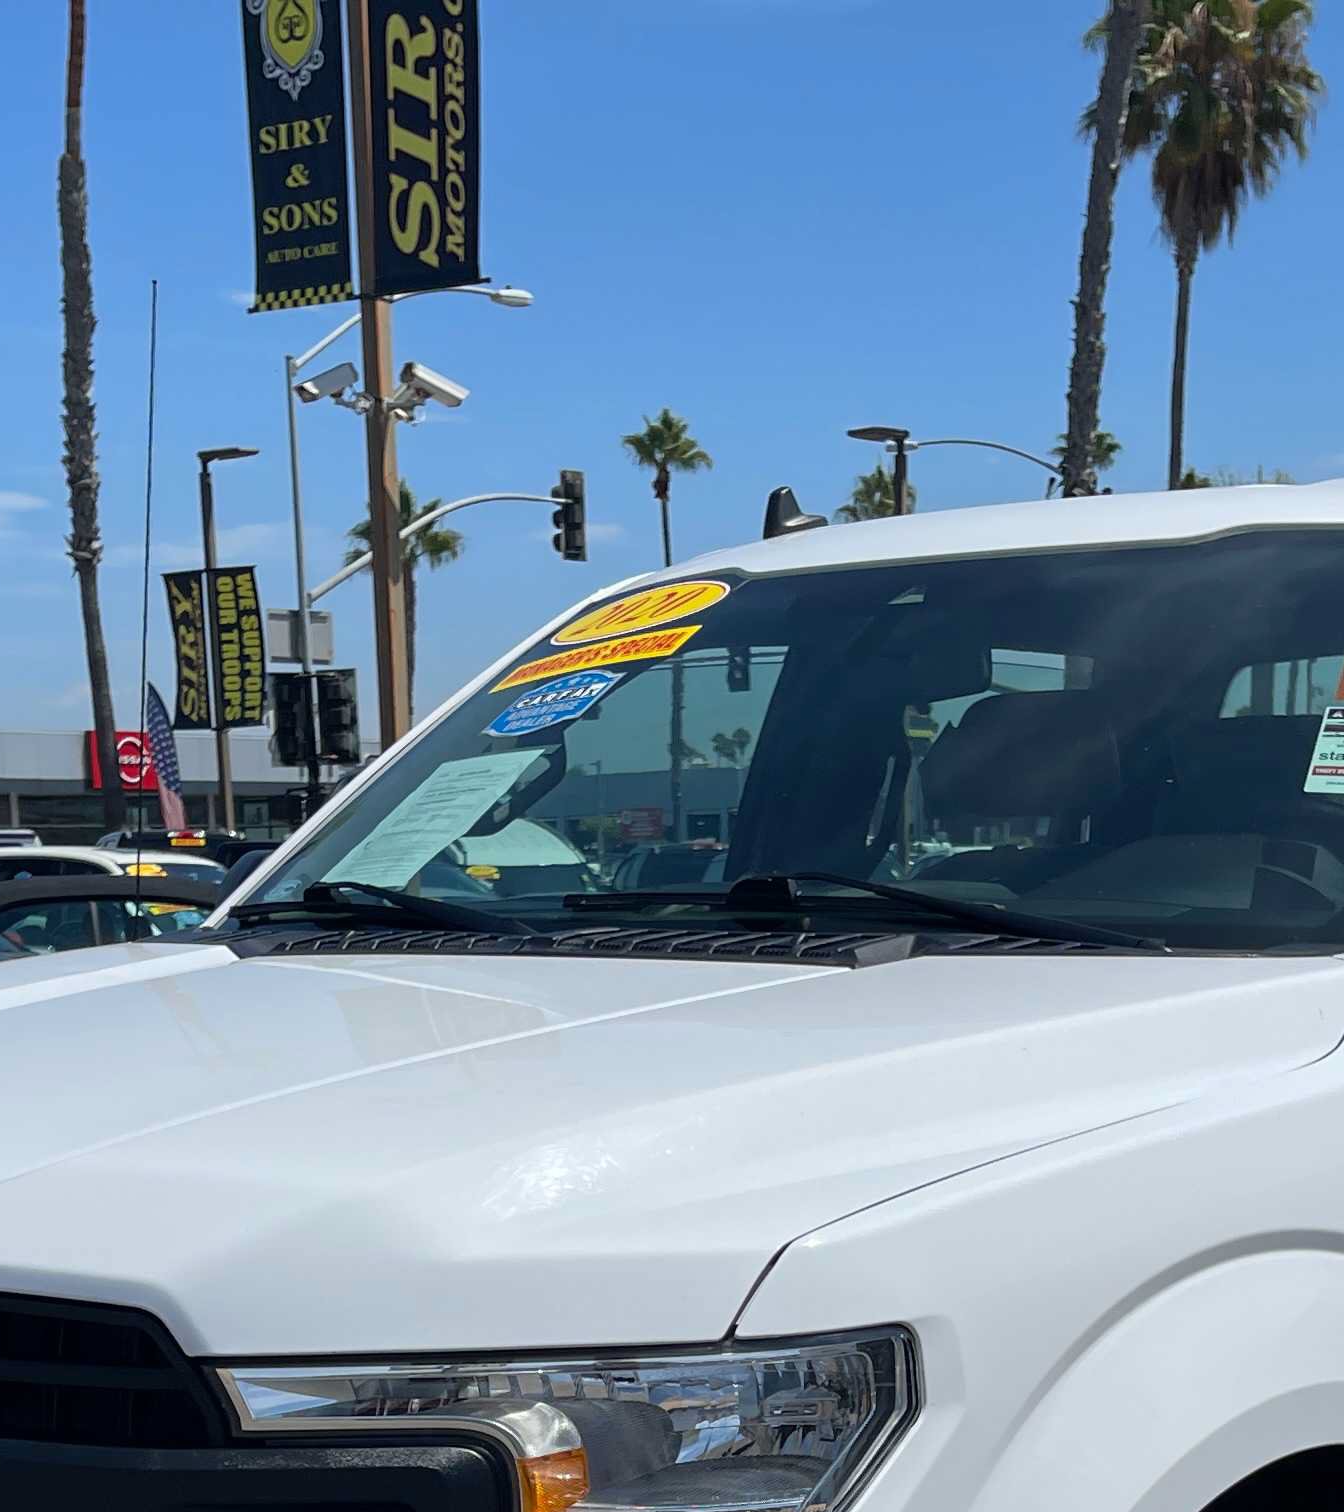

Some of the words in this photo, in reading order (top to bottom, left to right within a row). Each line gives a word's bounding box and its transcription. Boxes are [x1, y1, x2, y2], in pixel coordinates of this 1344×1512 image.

[259, 114, 333, 155] SIRY
[285, 163, 311, 188] &
[262, 198, 339, 236] SONS
[266, 247, 301, 264] AUTO
[303, 242, 338, 259] CARE
[216, 576, 237, 625] OUR
[235, 572, 256, 610] WE
[566, 586, 709, 638] 2020
[602, 631, 683, 660] SPECIAL
[220, 628, 243, 721] TROOPS
[240, 614, 263, 721] SUPPORT
